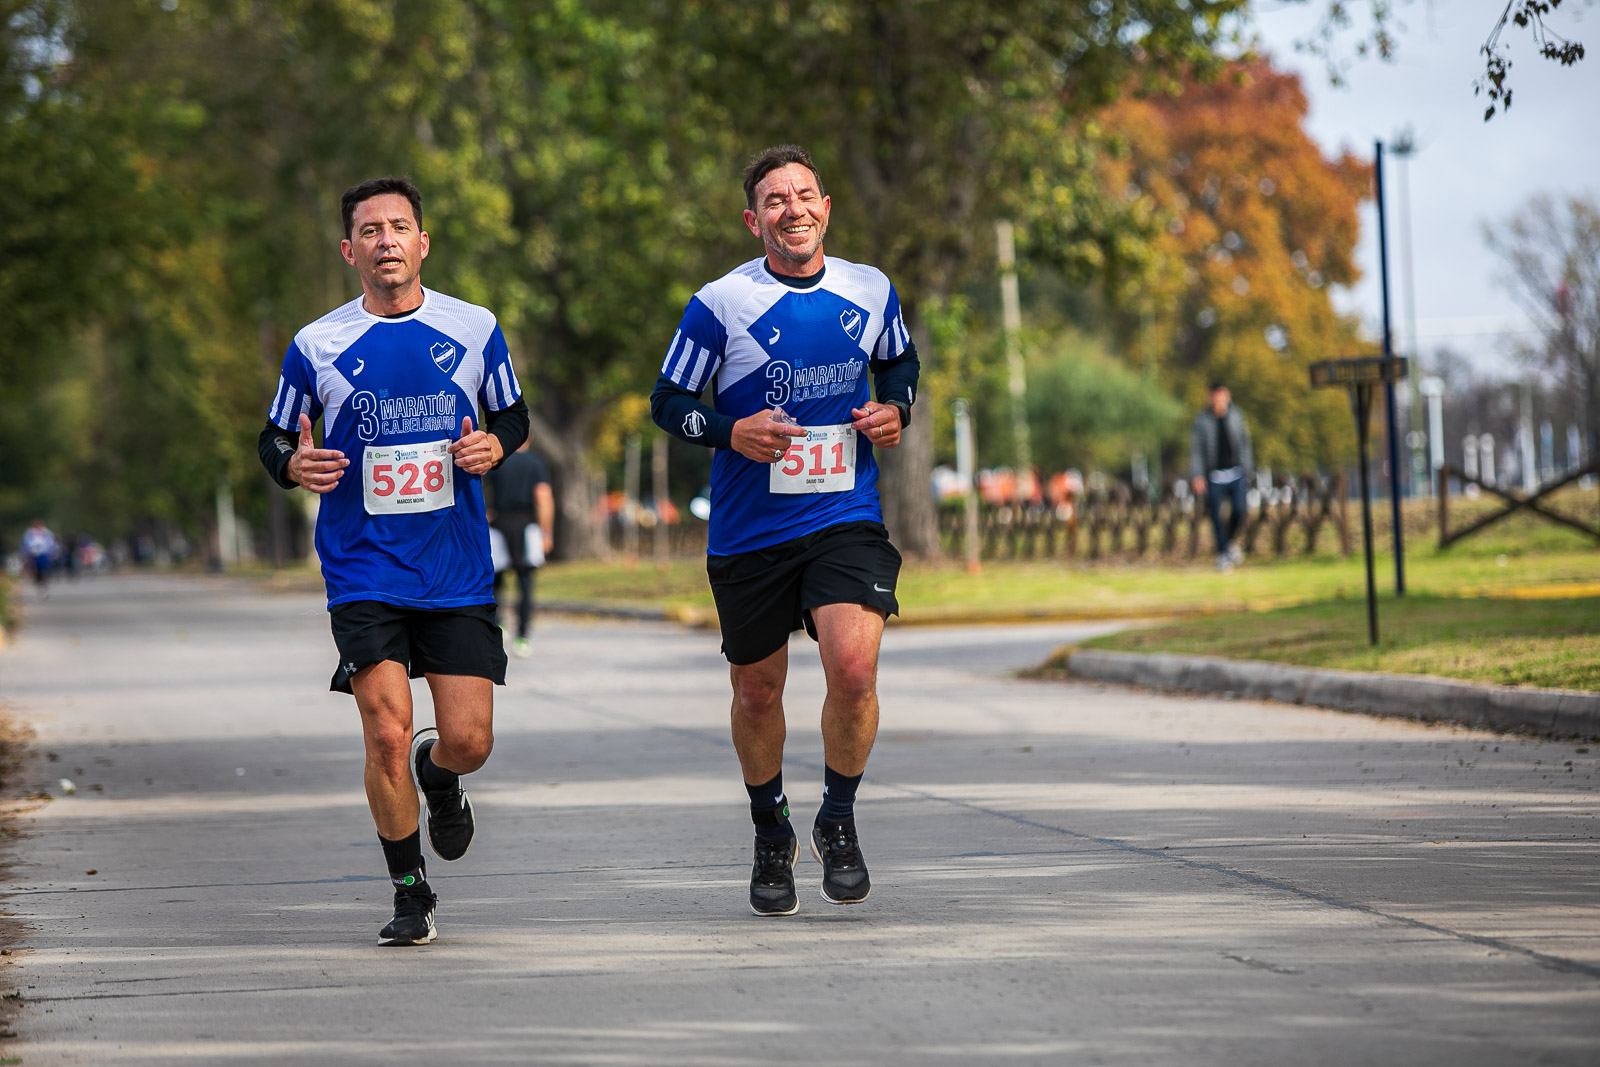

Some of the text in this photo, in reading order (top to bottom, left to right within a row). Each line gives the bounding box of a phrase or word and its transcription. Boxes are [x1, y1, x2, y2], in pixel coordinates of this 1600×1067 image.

[766, 360, 791, 406] 3
[794, 358, 863, 388] MARATÓN
[352, 390, 379, 442] 3
[380, 390, 456, 420] MARATÓN
[395, 450, 401, 461] 3
[781, 442, 847, 476] 511
[372, 460, 445, 497] 528
